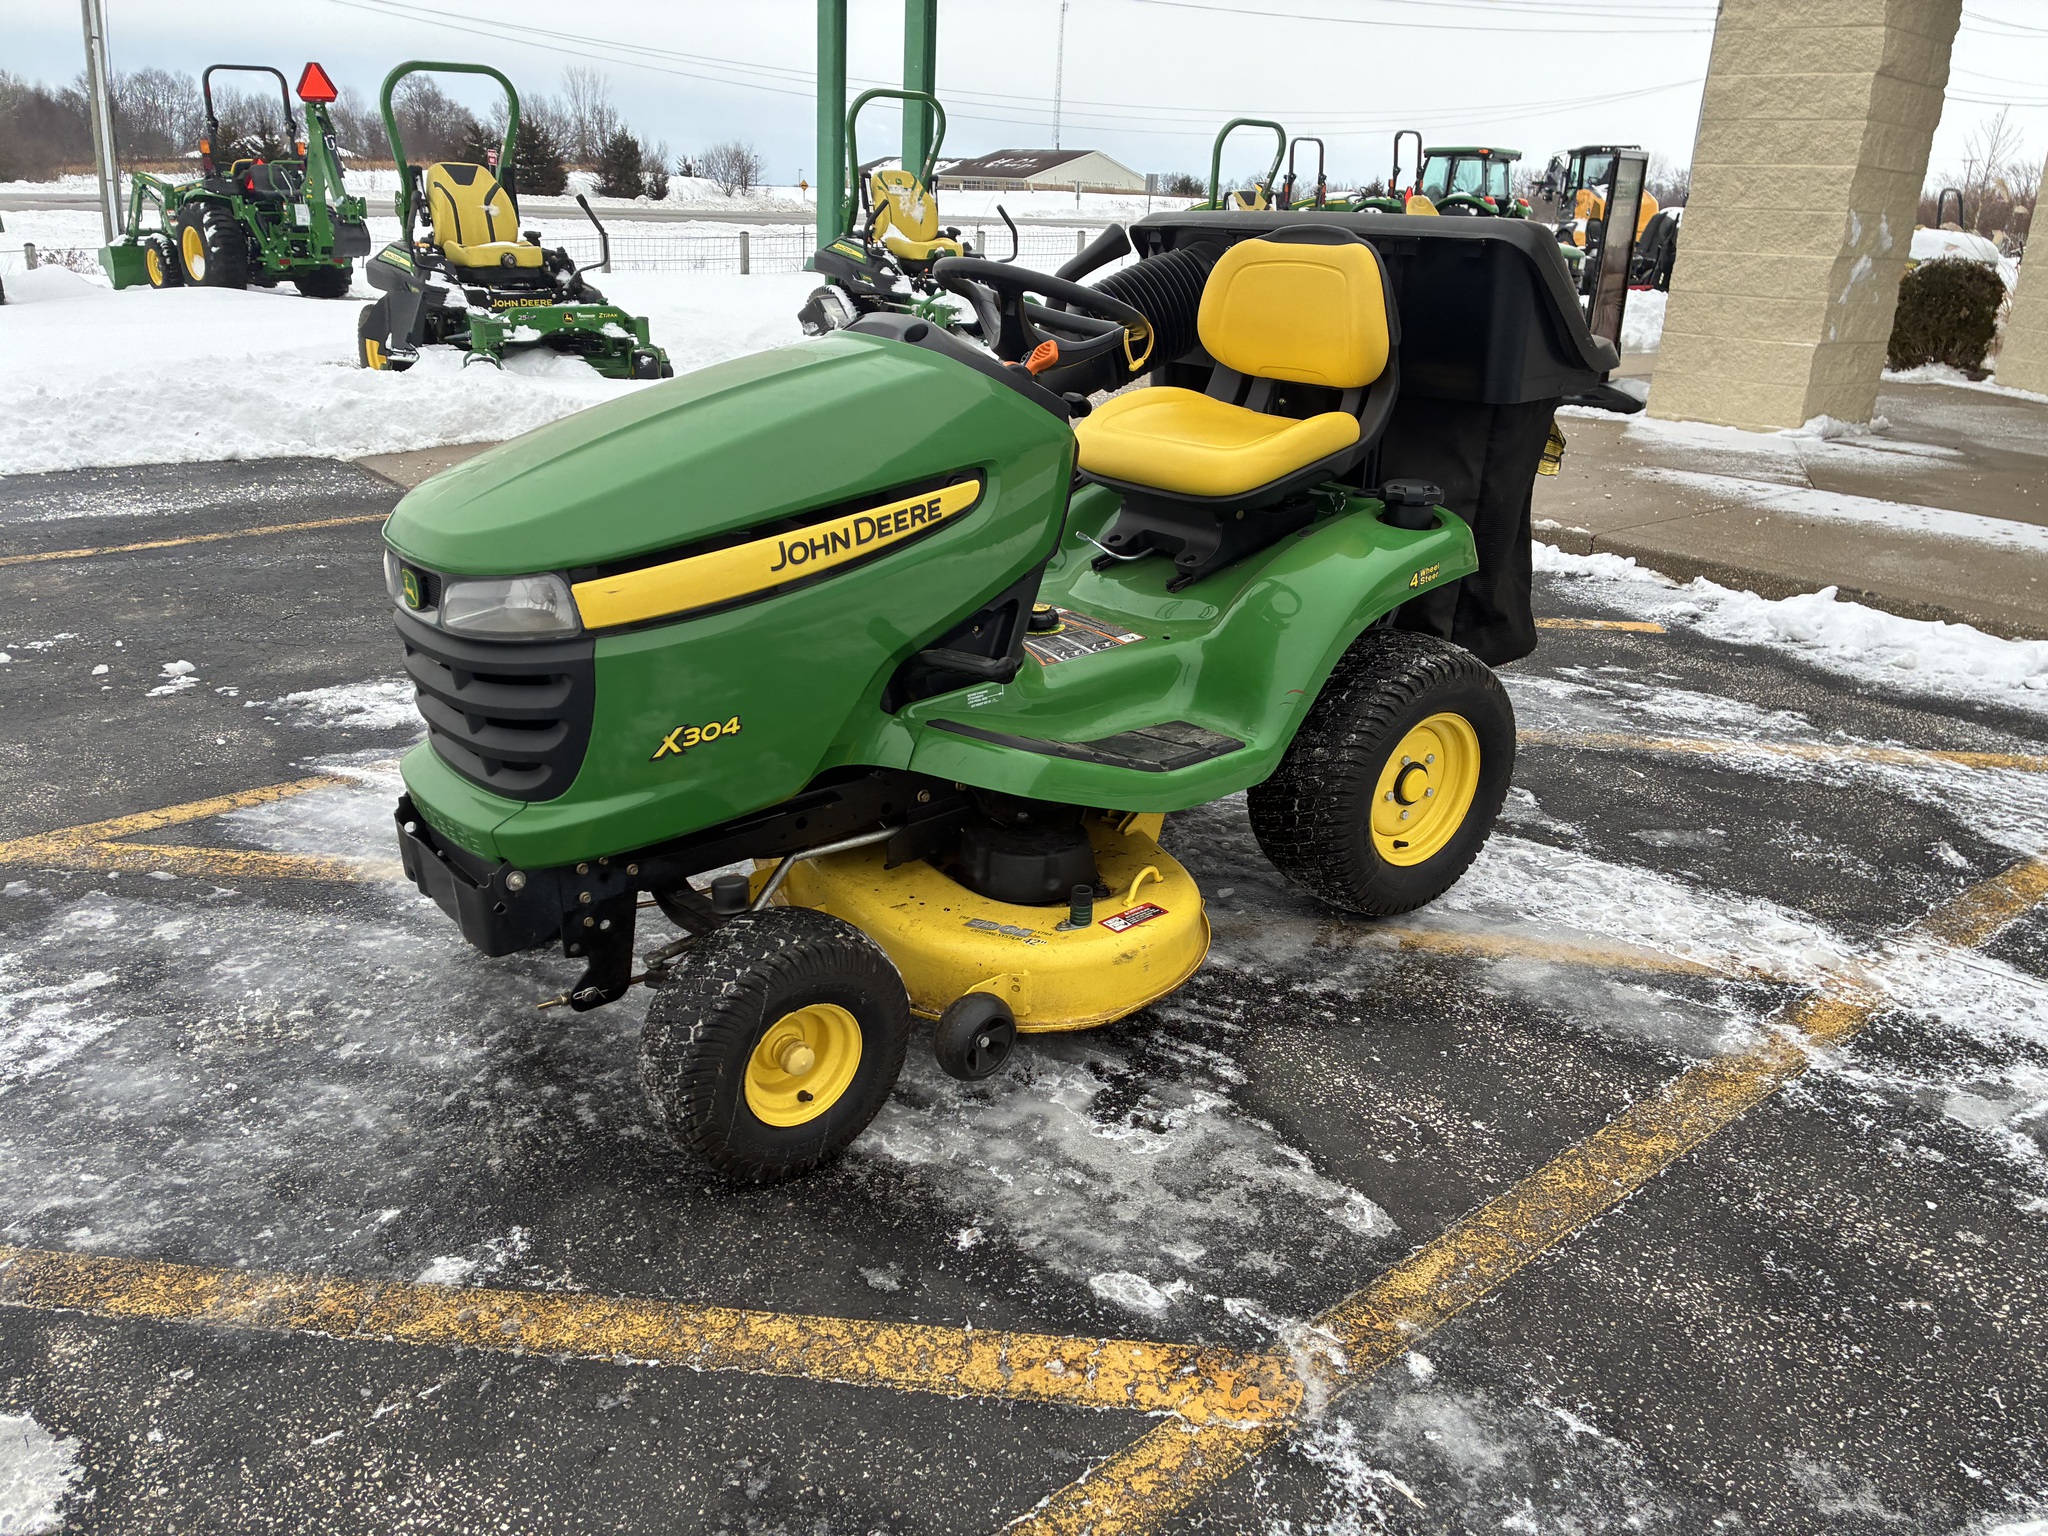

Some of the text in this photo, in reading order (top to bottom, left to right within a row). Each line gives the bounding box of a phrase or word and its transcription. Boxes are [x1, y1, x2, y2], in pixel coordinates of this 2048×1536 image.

[491, 298, 553, 308] JOHN DEERE
[770, 497, 943, 572] JOHN DEERE
[1409, 561, 1440, 588] 4 Wheel
[1420, 571, 1439, 585] Steer
[650, 715, 742, 760] X304
[962, 917, 1036, 938] EDGE
[1023, 938, 1048, 946] 42"
